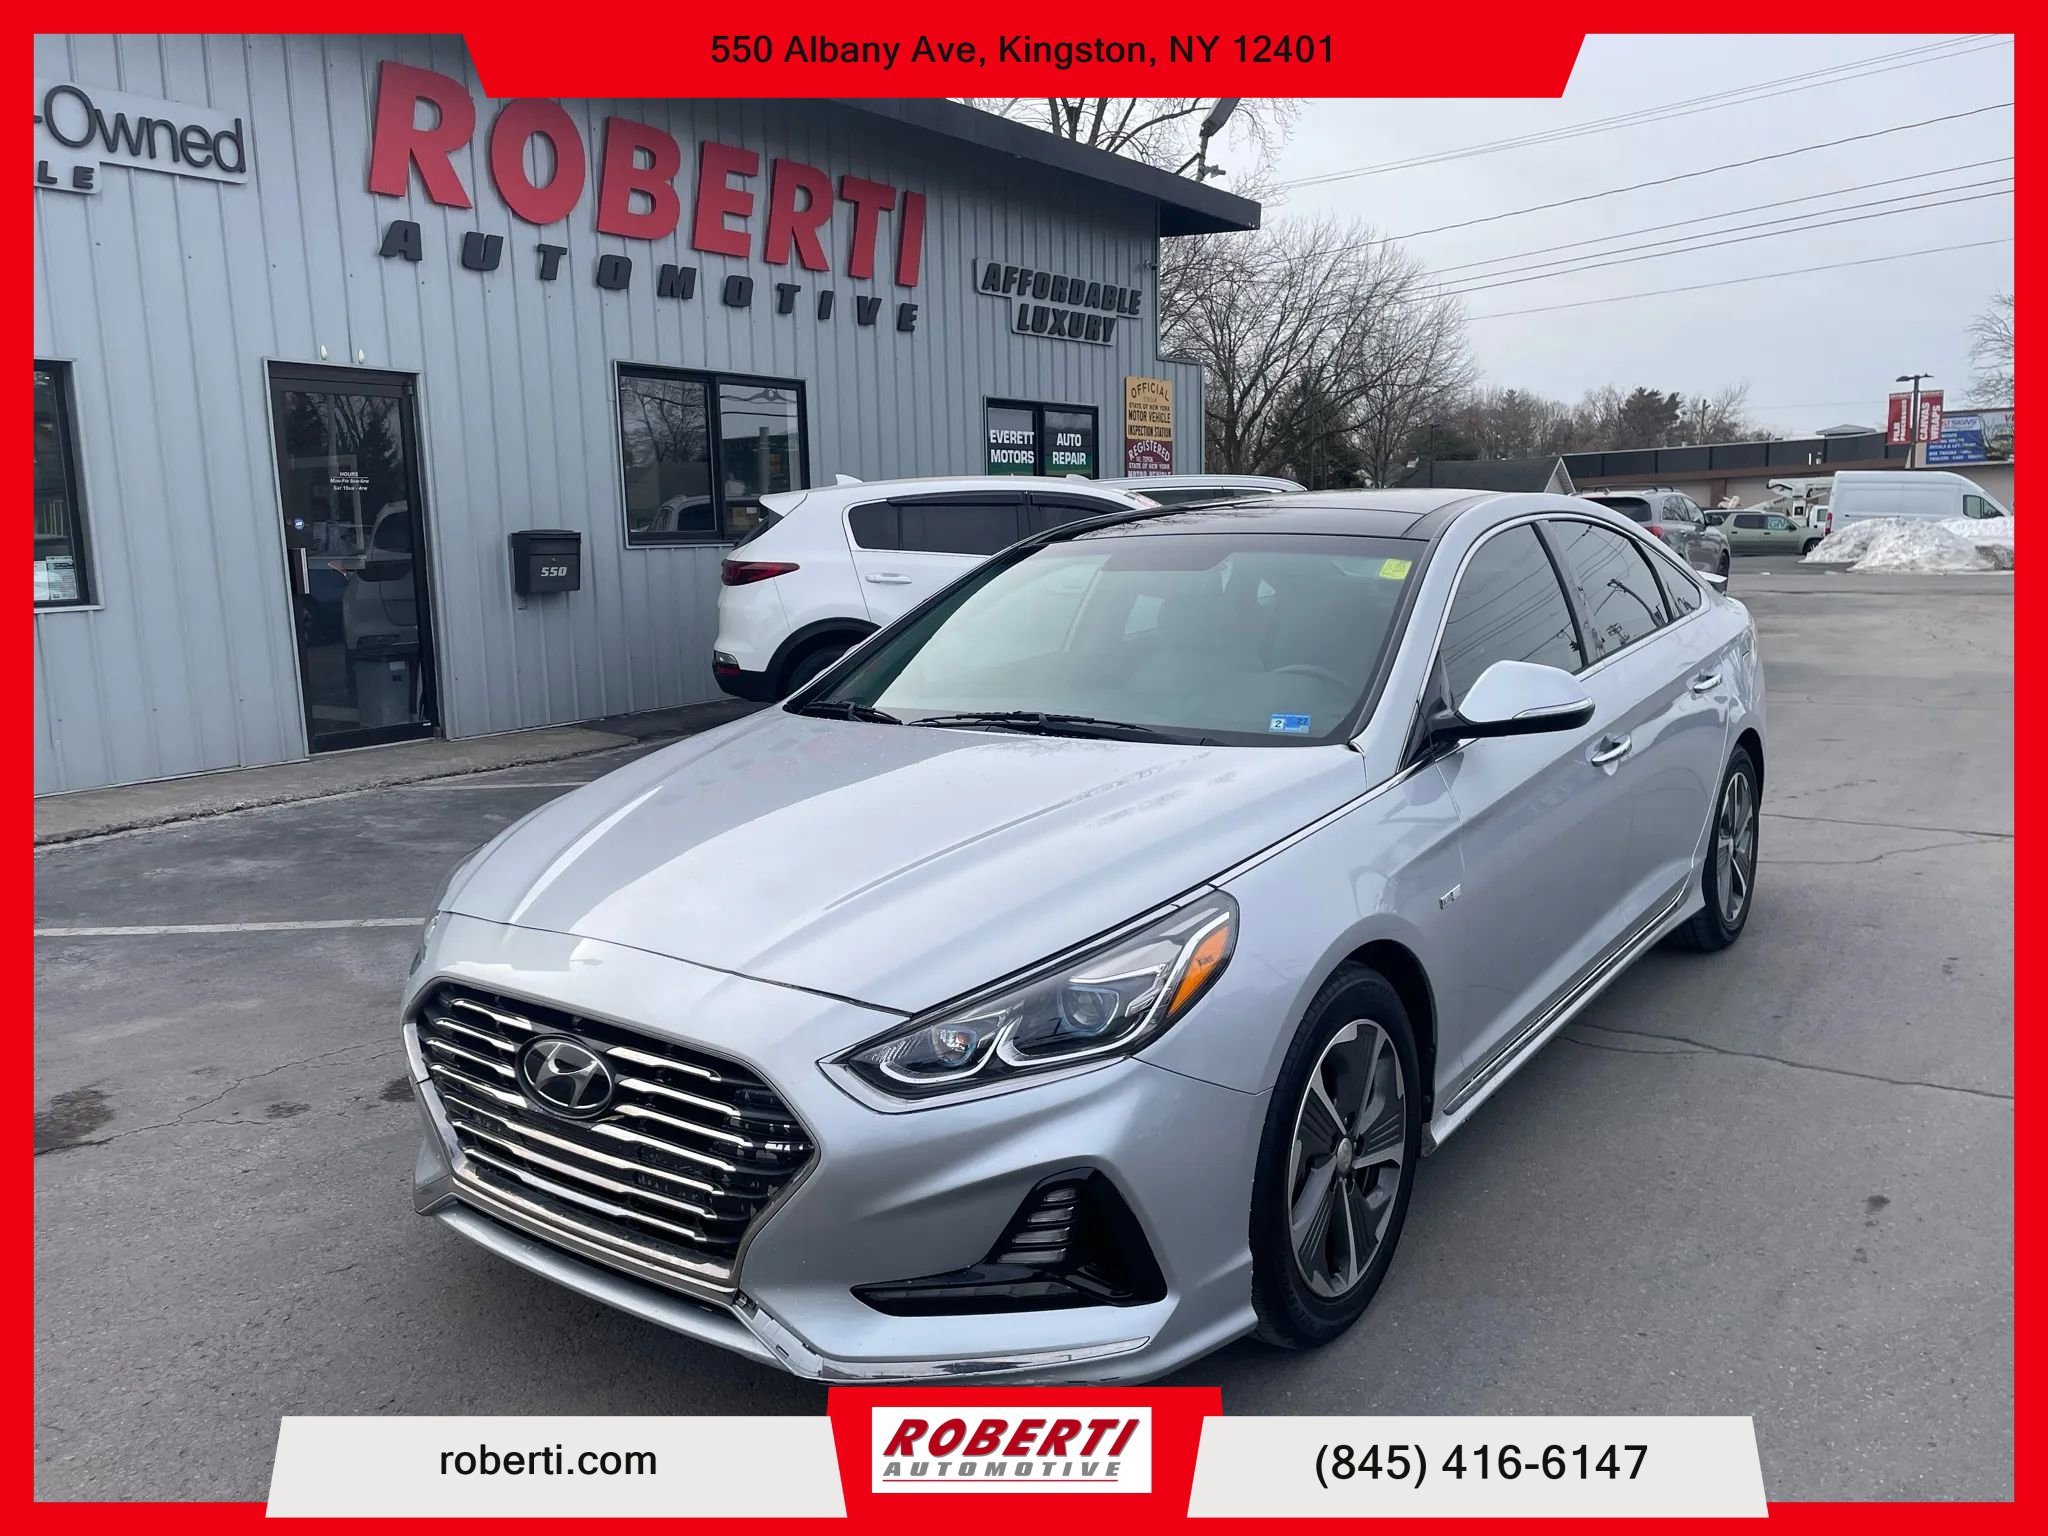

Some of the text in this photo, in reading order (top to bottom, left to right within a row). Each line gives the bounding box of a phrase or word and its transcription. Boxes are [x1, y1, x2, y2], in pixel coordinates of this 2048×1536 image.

[369, 60, 926, 288] ROBERTI
[379, 219, 919, 332] AUTOMOTIVE
[981, 262, 1142, 315] AFFORDABLE
[1016, 303, 1117, 342] LUXURY
[1131, 381, 1169, 402] OFFICIAL
[1129, 409, 1171, 424] MOTOR VEHICLE
[1920, 402, 1930, 440] CANVAS
[1930, 404, 1941, 441] WRAPS
[990, 429, 1034, 445] EVERETT
[1056, 433, 1082, 447] AUTO
[1128, 424, 1171, 438] INSPECTION STATION
[990, 449, 1035, 464] MOTORS
[1052, 451, 1087, 465] REPAIR
[1128, 440, 1170, 462] REGISTERED
[541, 566, 568, 577] 550
